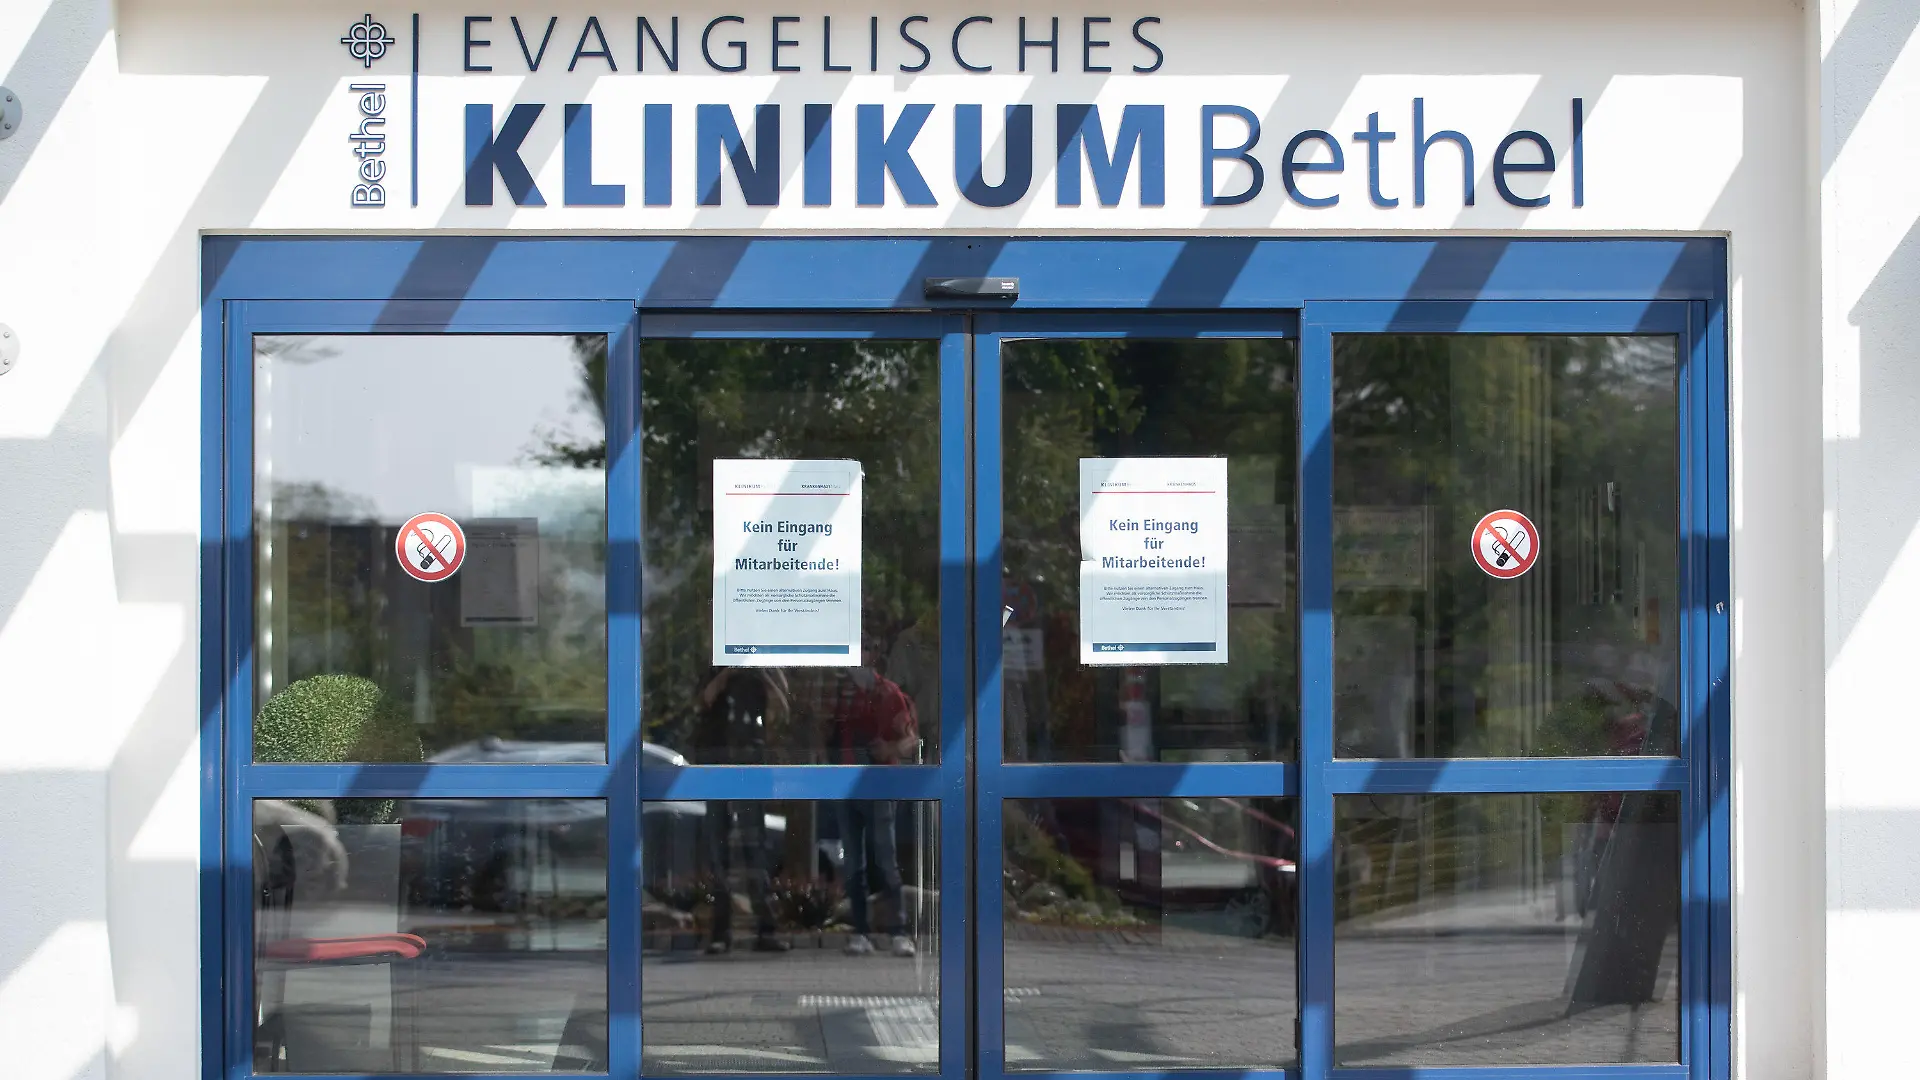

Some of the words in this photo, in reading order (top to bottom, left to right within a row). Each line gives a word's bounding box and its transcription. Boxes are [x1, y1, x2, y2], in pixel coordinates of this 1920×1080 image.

[464, 15, 1165, 73] EVANGELISCHES
[348, 82, 387, 208] Bethel
[464, 103, 1166, 208] KLINIKUM
[1200, 97, 1584, 208] Bethel
[743, 520, 773, 533] Kein
[777, 520, 833, 536] Eingang
[1109, 518, 1139, 531] Kein
[1143, 518, 1199, 534] Eingang
[777, 538, 798, 552] für
[1143, 537, 1164, 550] für
[735, 557, 840, 571] Mitarbeitende!
[1102, 555, 1206, 569] Mitarbeitende!
